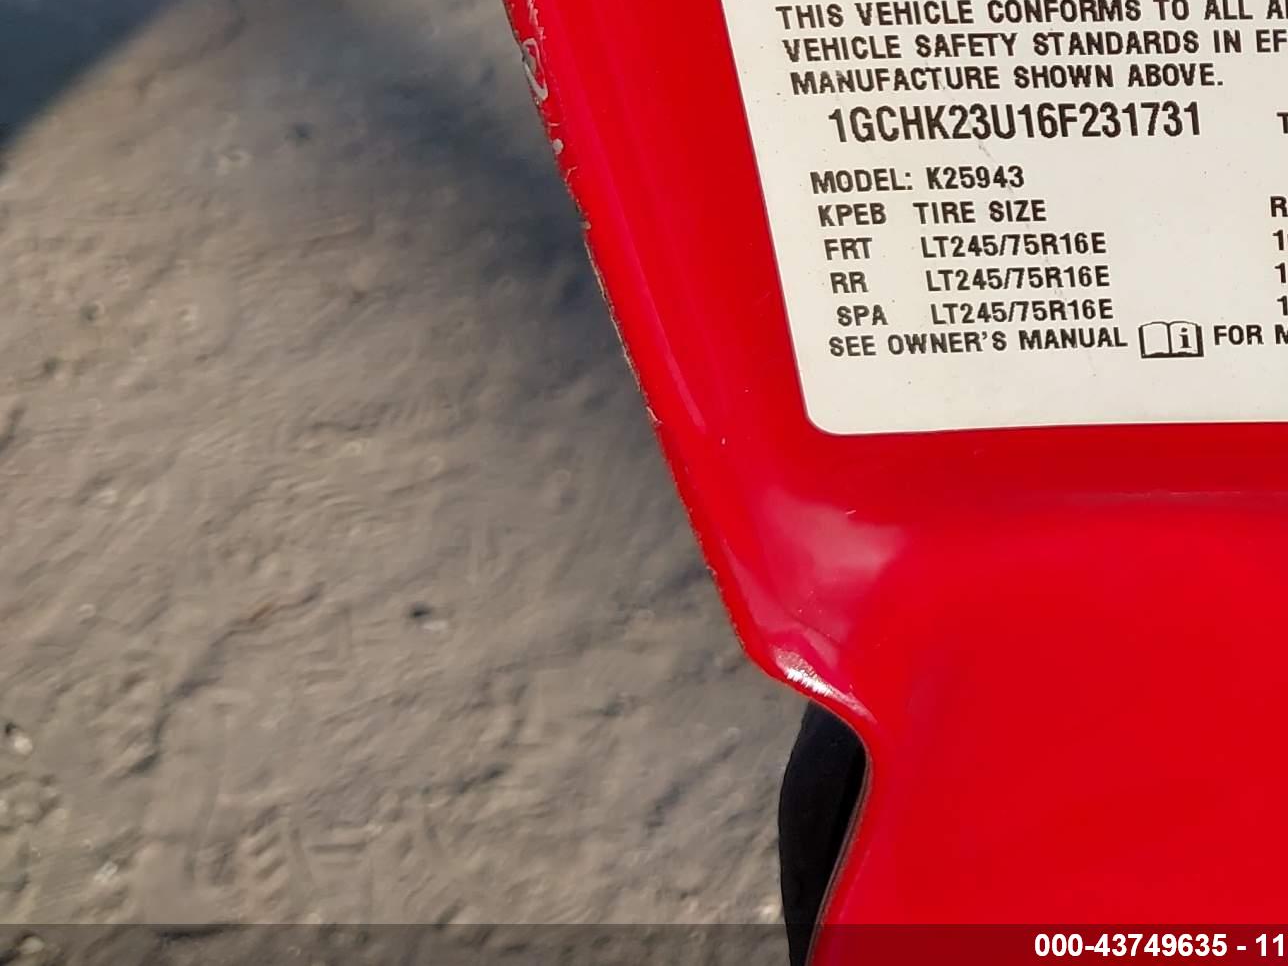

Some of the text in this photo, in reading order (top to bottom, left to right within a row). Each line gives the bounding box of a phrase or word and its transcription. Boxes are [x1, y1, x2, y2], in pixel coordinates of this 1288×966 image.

[776, 4, 843, 29] THIS
[855, 0, 973, 26] VEHICLE
[782, 35, 901, 62] VEHICLE
[915, 33, 1017, 57] SAFETY
[1033, 31, 1199, 55] STANDARDS
[1214, 30, 1241, 53] IN
[790, 63, 1223, 95] MANUFACTURE SHOWN ABOVE.
[829, 101, 1199, 142] 1GCHK23U16F231731
[810, 166, 1024, 194] MODEL: K25943
[818, 200, 1046, 226] KPEB TIRE SIZE
[824, 238, 872, 260] FRT
[921, 233, 1106, 258] LT245/75R16E
[830, 272, 867, 293] RR
[926, 266, 1109, 291] LT245/75R16E
[837, 305, 888, 326] SPA
[931, 299, 1113, 324] LT245/75R16E
[829, 336, 876, 356] SEE
[888, 331, 1006, 355] OWNER'S
[1019, 327, 1128, 350] MANUAL
[1214, 325, 1263, 345] FOR
